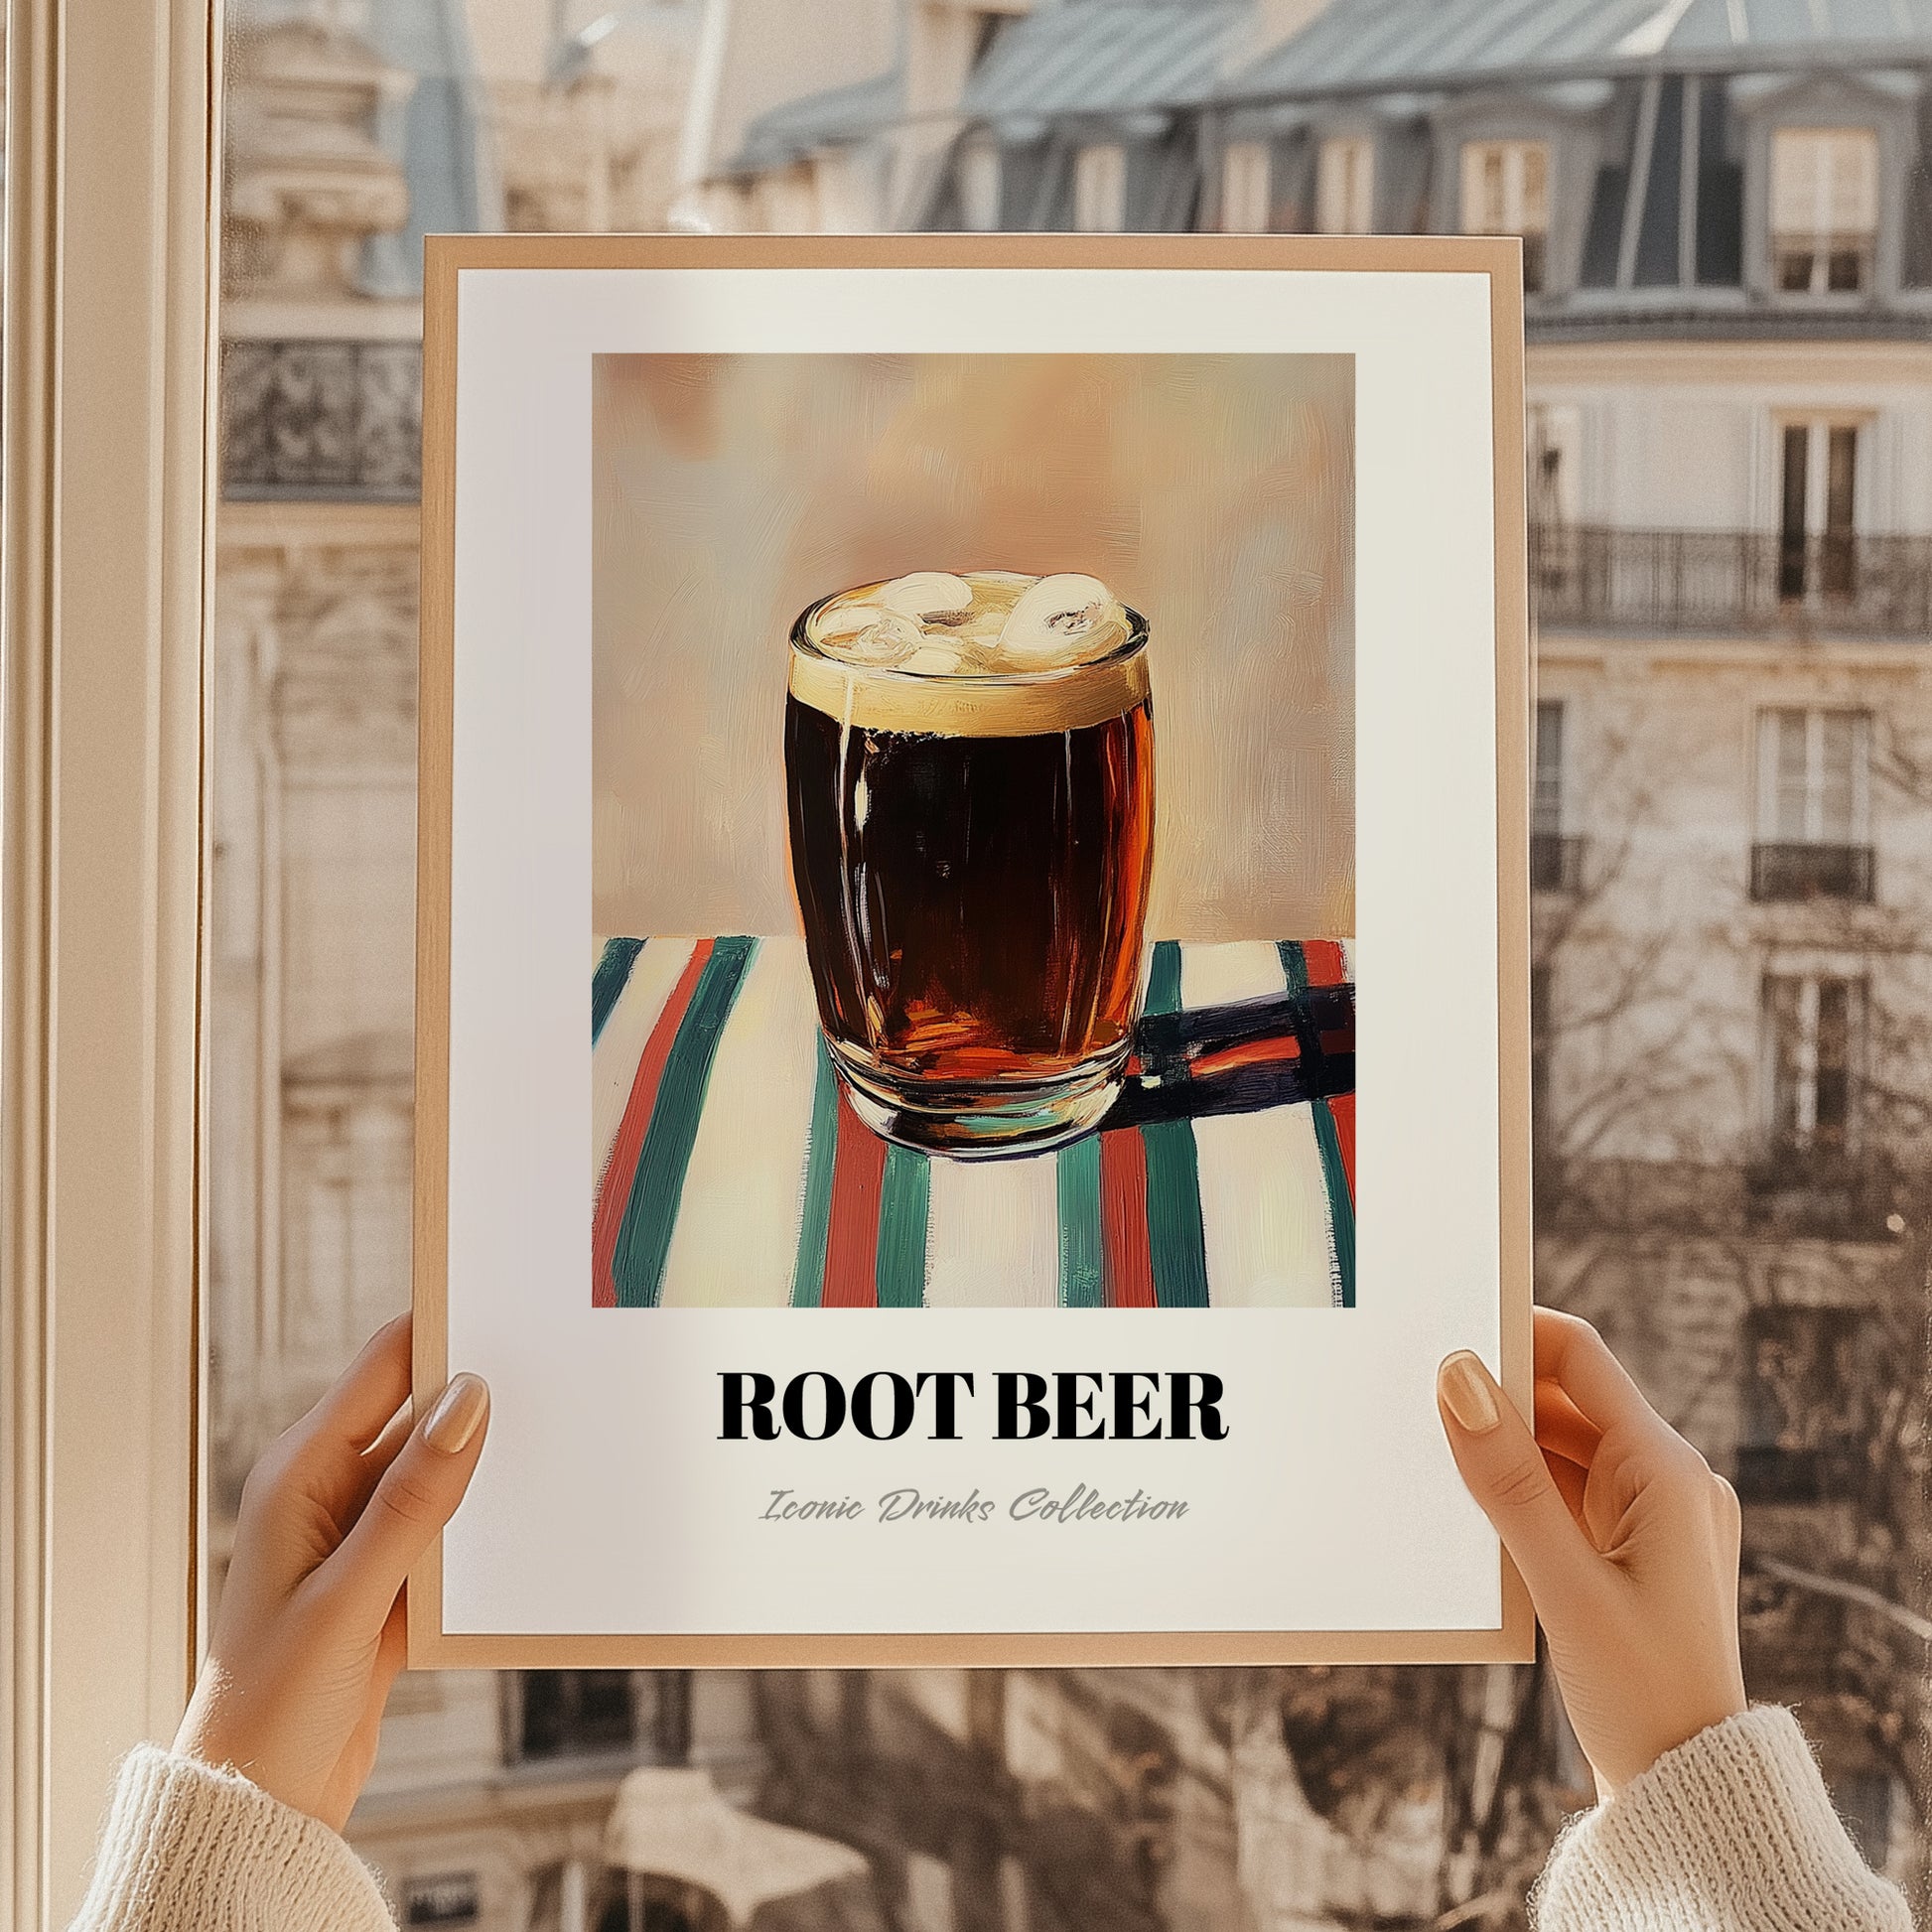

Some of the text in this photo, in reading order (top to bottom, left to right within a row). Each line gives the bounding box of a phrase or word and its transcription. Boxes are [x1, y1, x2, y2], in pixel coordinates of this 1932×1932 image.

[717, 1371, 1230, 1441] ROOT BEER
[759, 1481, 1190, 1524] Iconic Drinks Collection
